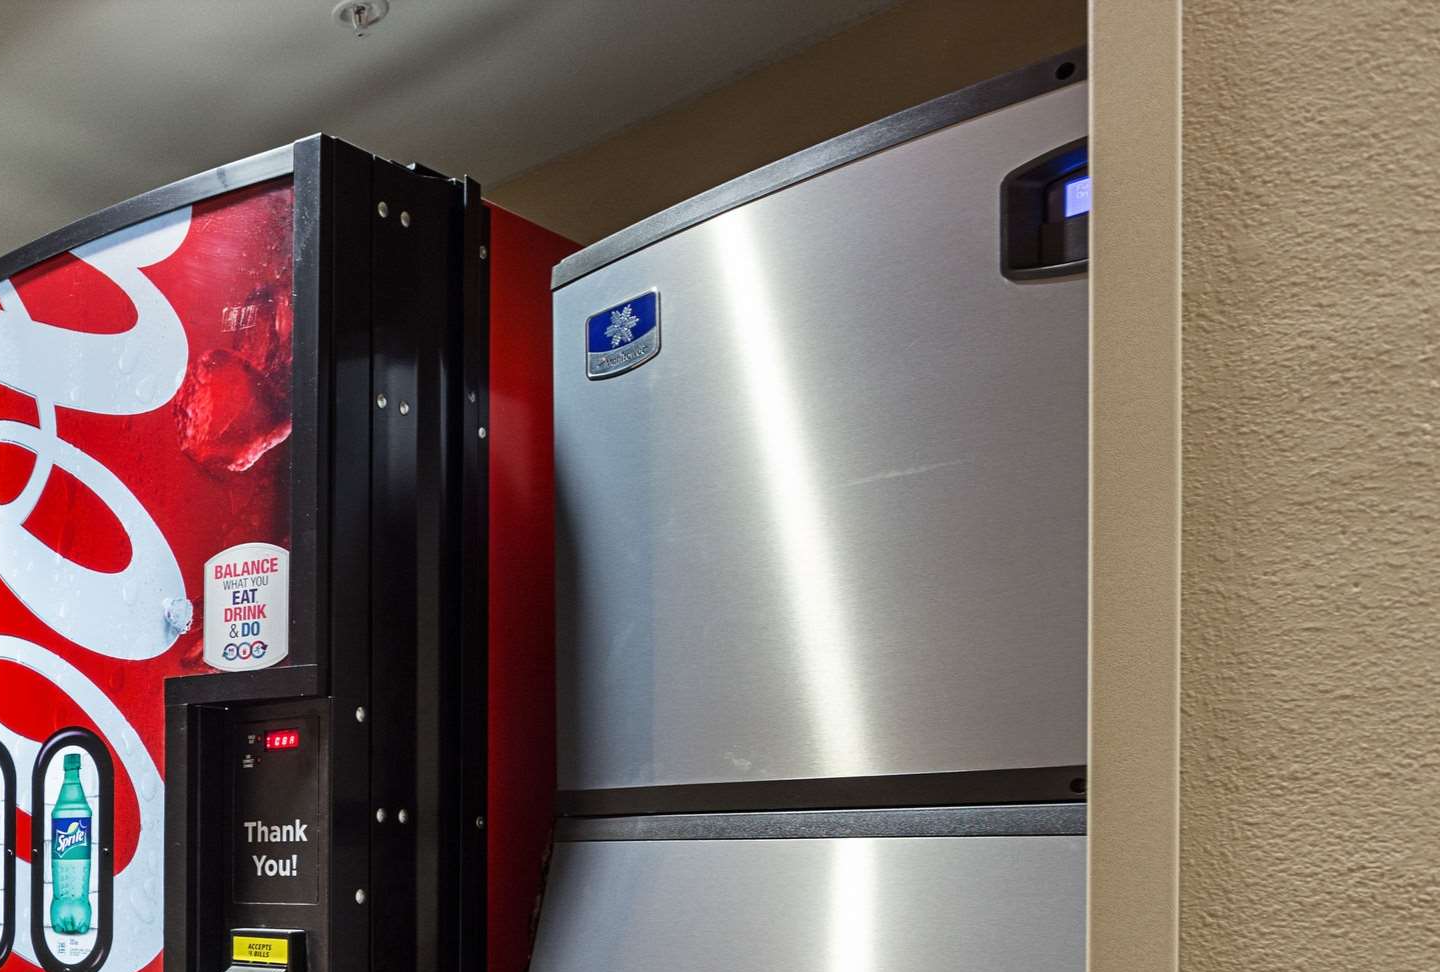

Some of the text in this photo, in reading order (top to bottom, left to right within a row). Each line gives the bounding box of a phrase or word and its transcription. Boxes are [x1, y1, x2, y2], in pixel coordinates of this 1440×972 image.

[214, 556, 279, 579] BALANCE
[223, 575, 269, 590] WHAT YOU
[232, 588, 258, 605] EAT
[224, 604, 267, 622] DRINK
[229, 621, 260, 639] & DO
[244, 819, 308, 843] Thank
[56, 831, 85, 853] Sprite
[252, 854, 299, 877] You!
[247, 943, 272, 951] ACCEPTS
